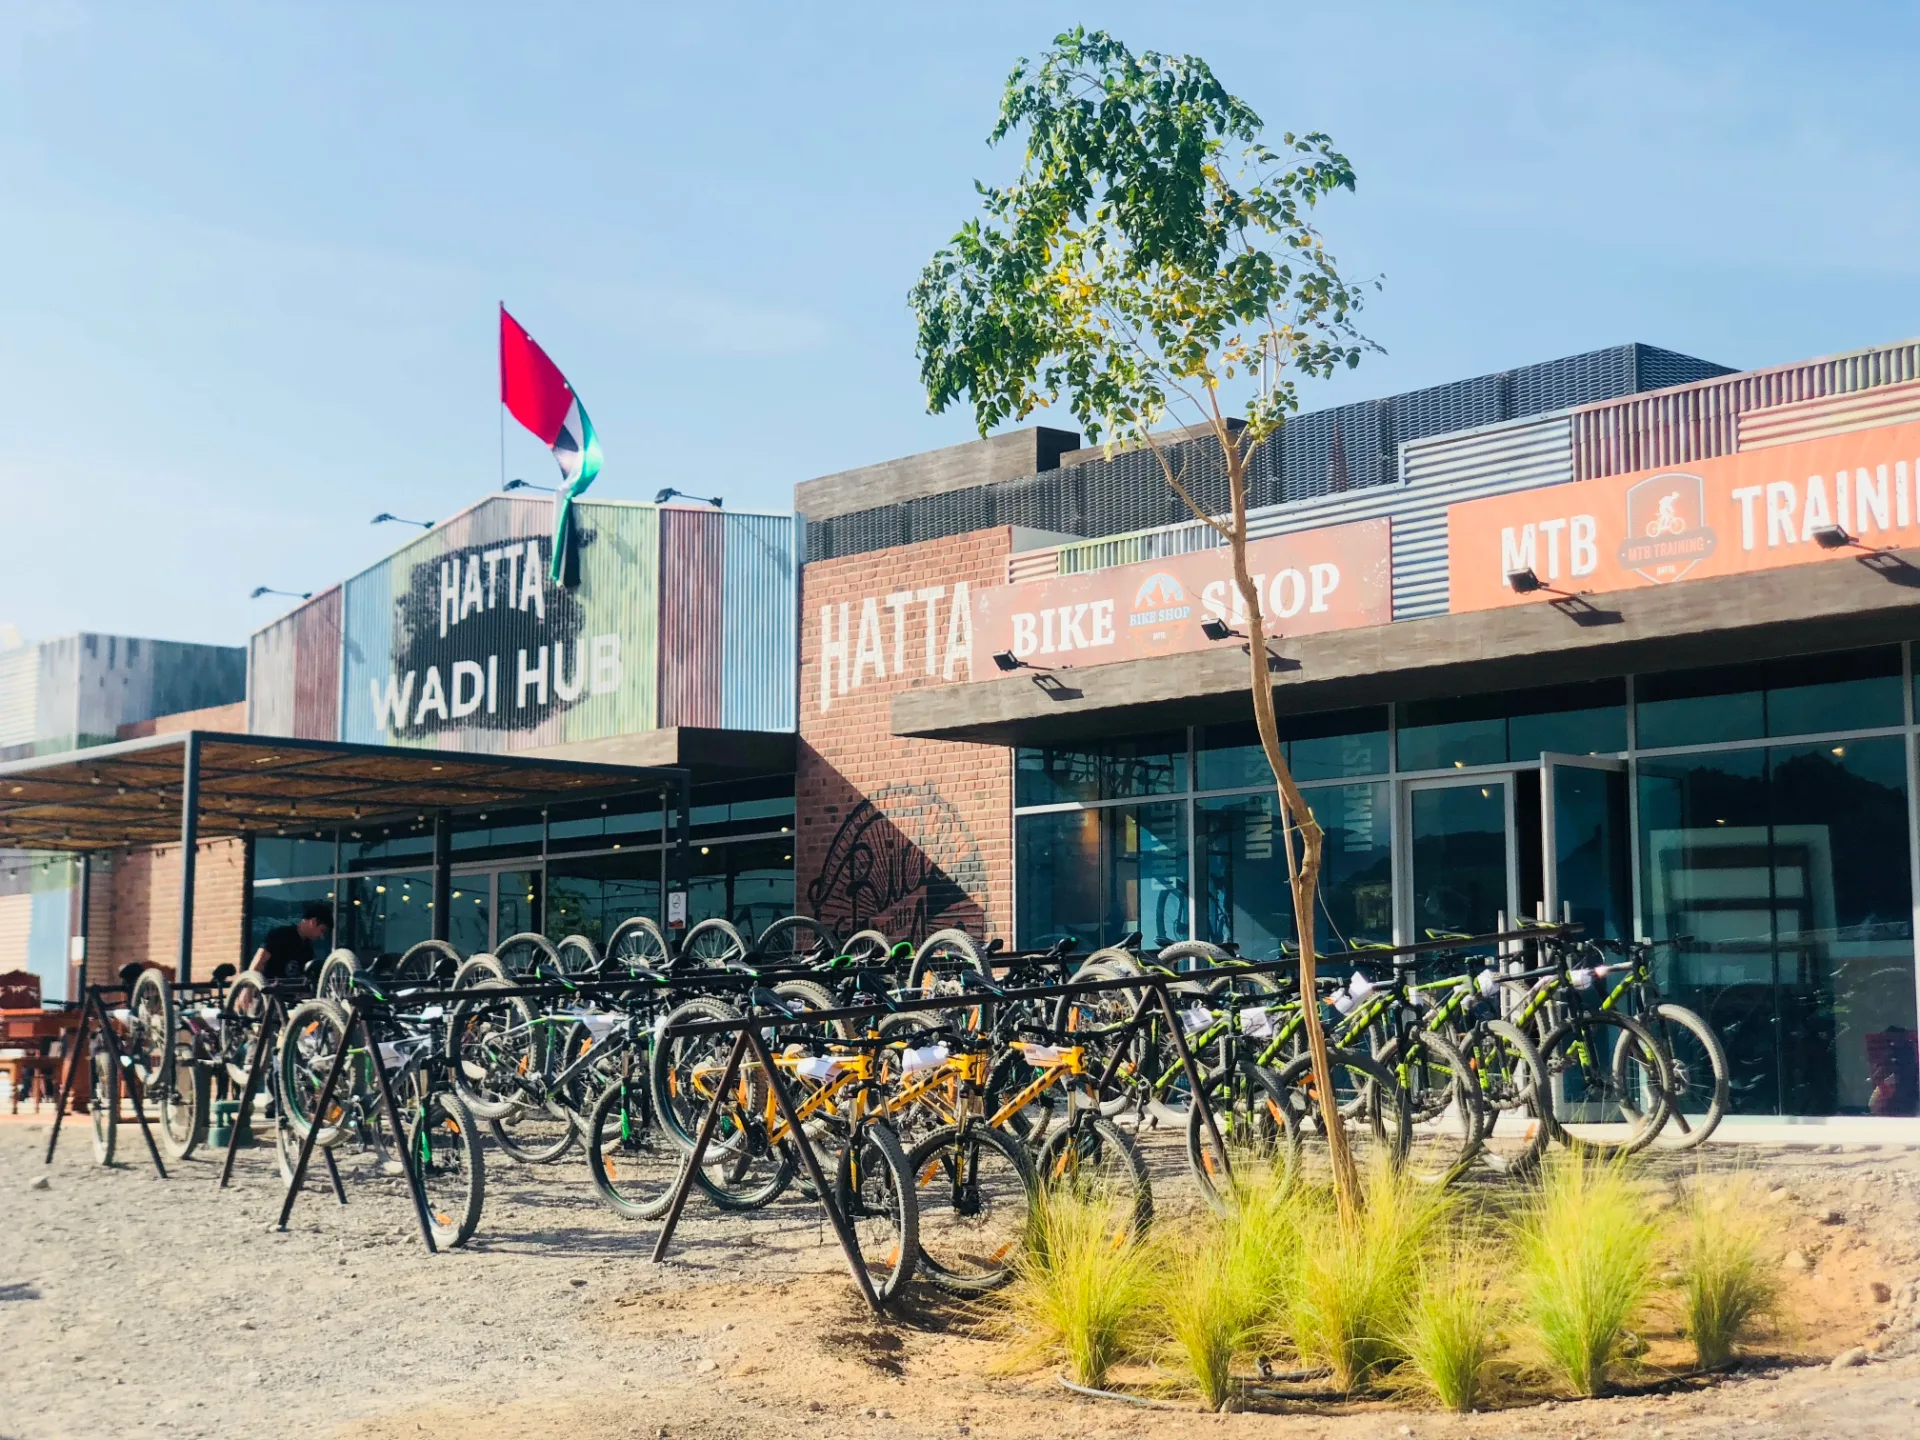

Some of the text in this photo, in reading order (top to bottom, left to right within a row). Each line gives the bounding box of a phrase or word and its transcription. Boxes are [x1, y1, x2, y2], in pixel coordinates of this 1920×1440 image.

[1501, 457, 1920, 587] MTB TRAINI
[1628, 537, 1705, 561] MTB TRAINING
[440, 540, 545, 639] HATTA
[1011, 562, 1340, 658] BIKE SHOP
[1129, 606, 1190, 627] BIKE SHOP
[370, 633, 623, 731] WADI HUB
[820, 581, 973, 714] HATTA
